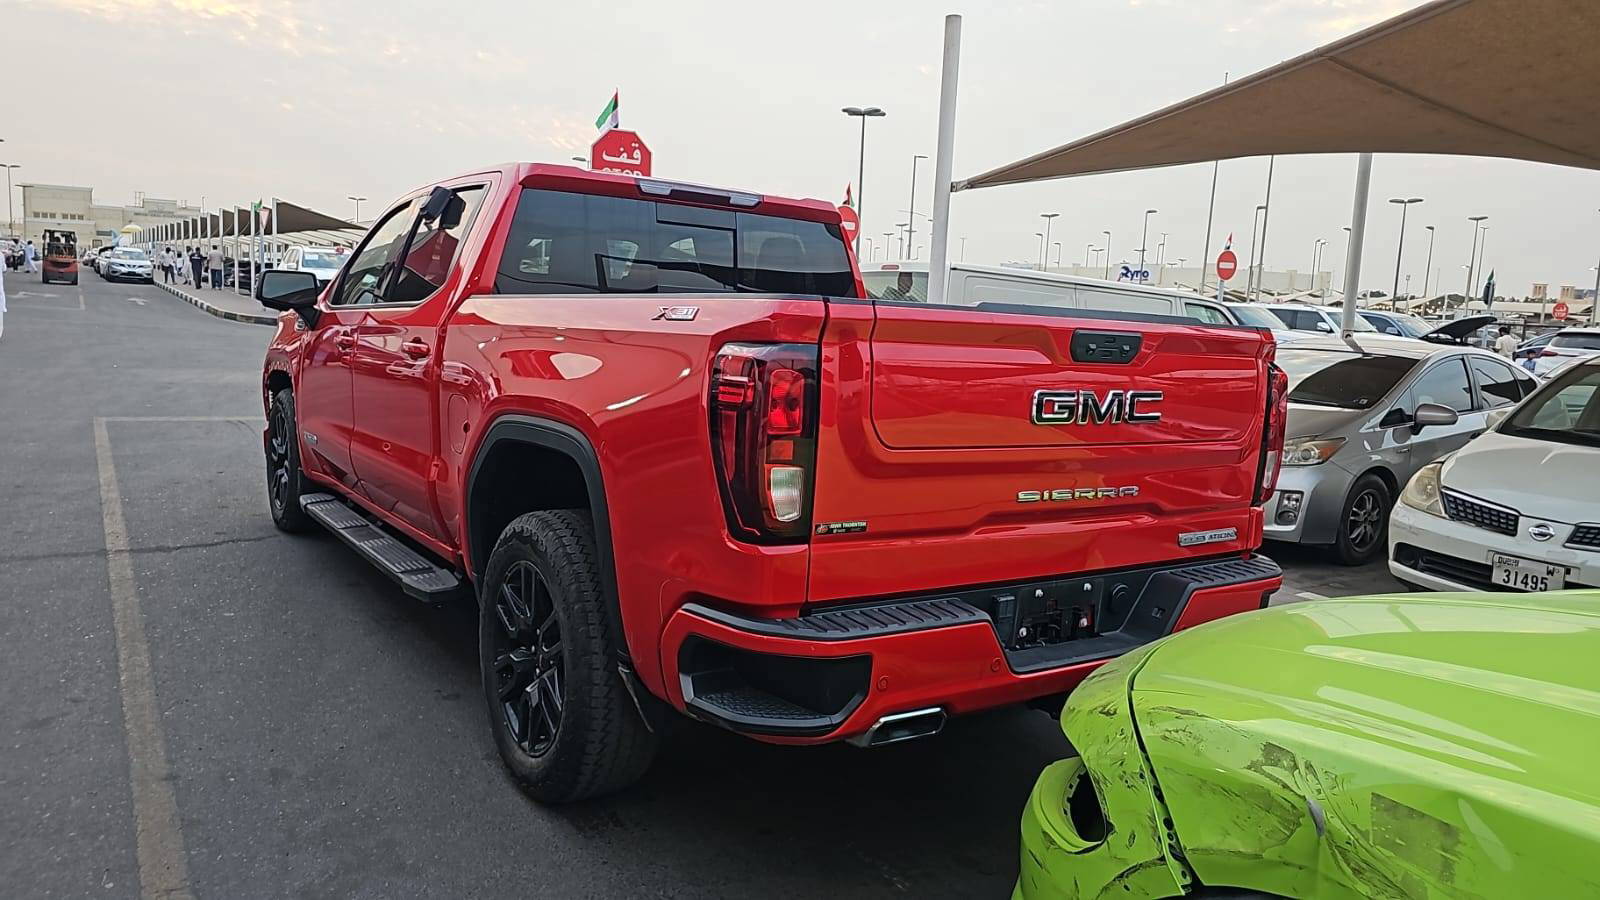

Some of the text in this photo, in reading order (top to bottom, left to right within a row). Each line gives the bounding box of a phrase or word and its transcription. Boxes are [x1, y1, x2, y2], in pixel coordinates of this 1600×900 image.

[602, 142, 641, 165] قف
[1033, 389, 1164, 424] GMC
[1017, 485, 1139, 502] SIERRA
[1502, 568, 1548, 592] 31495
